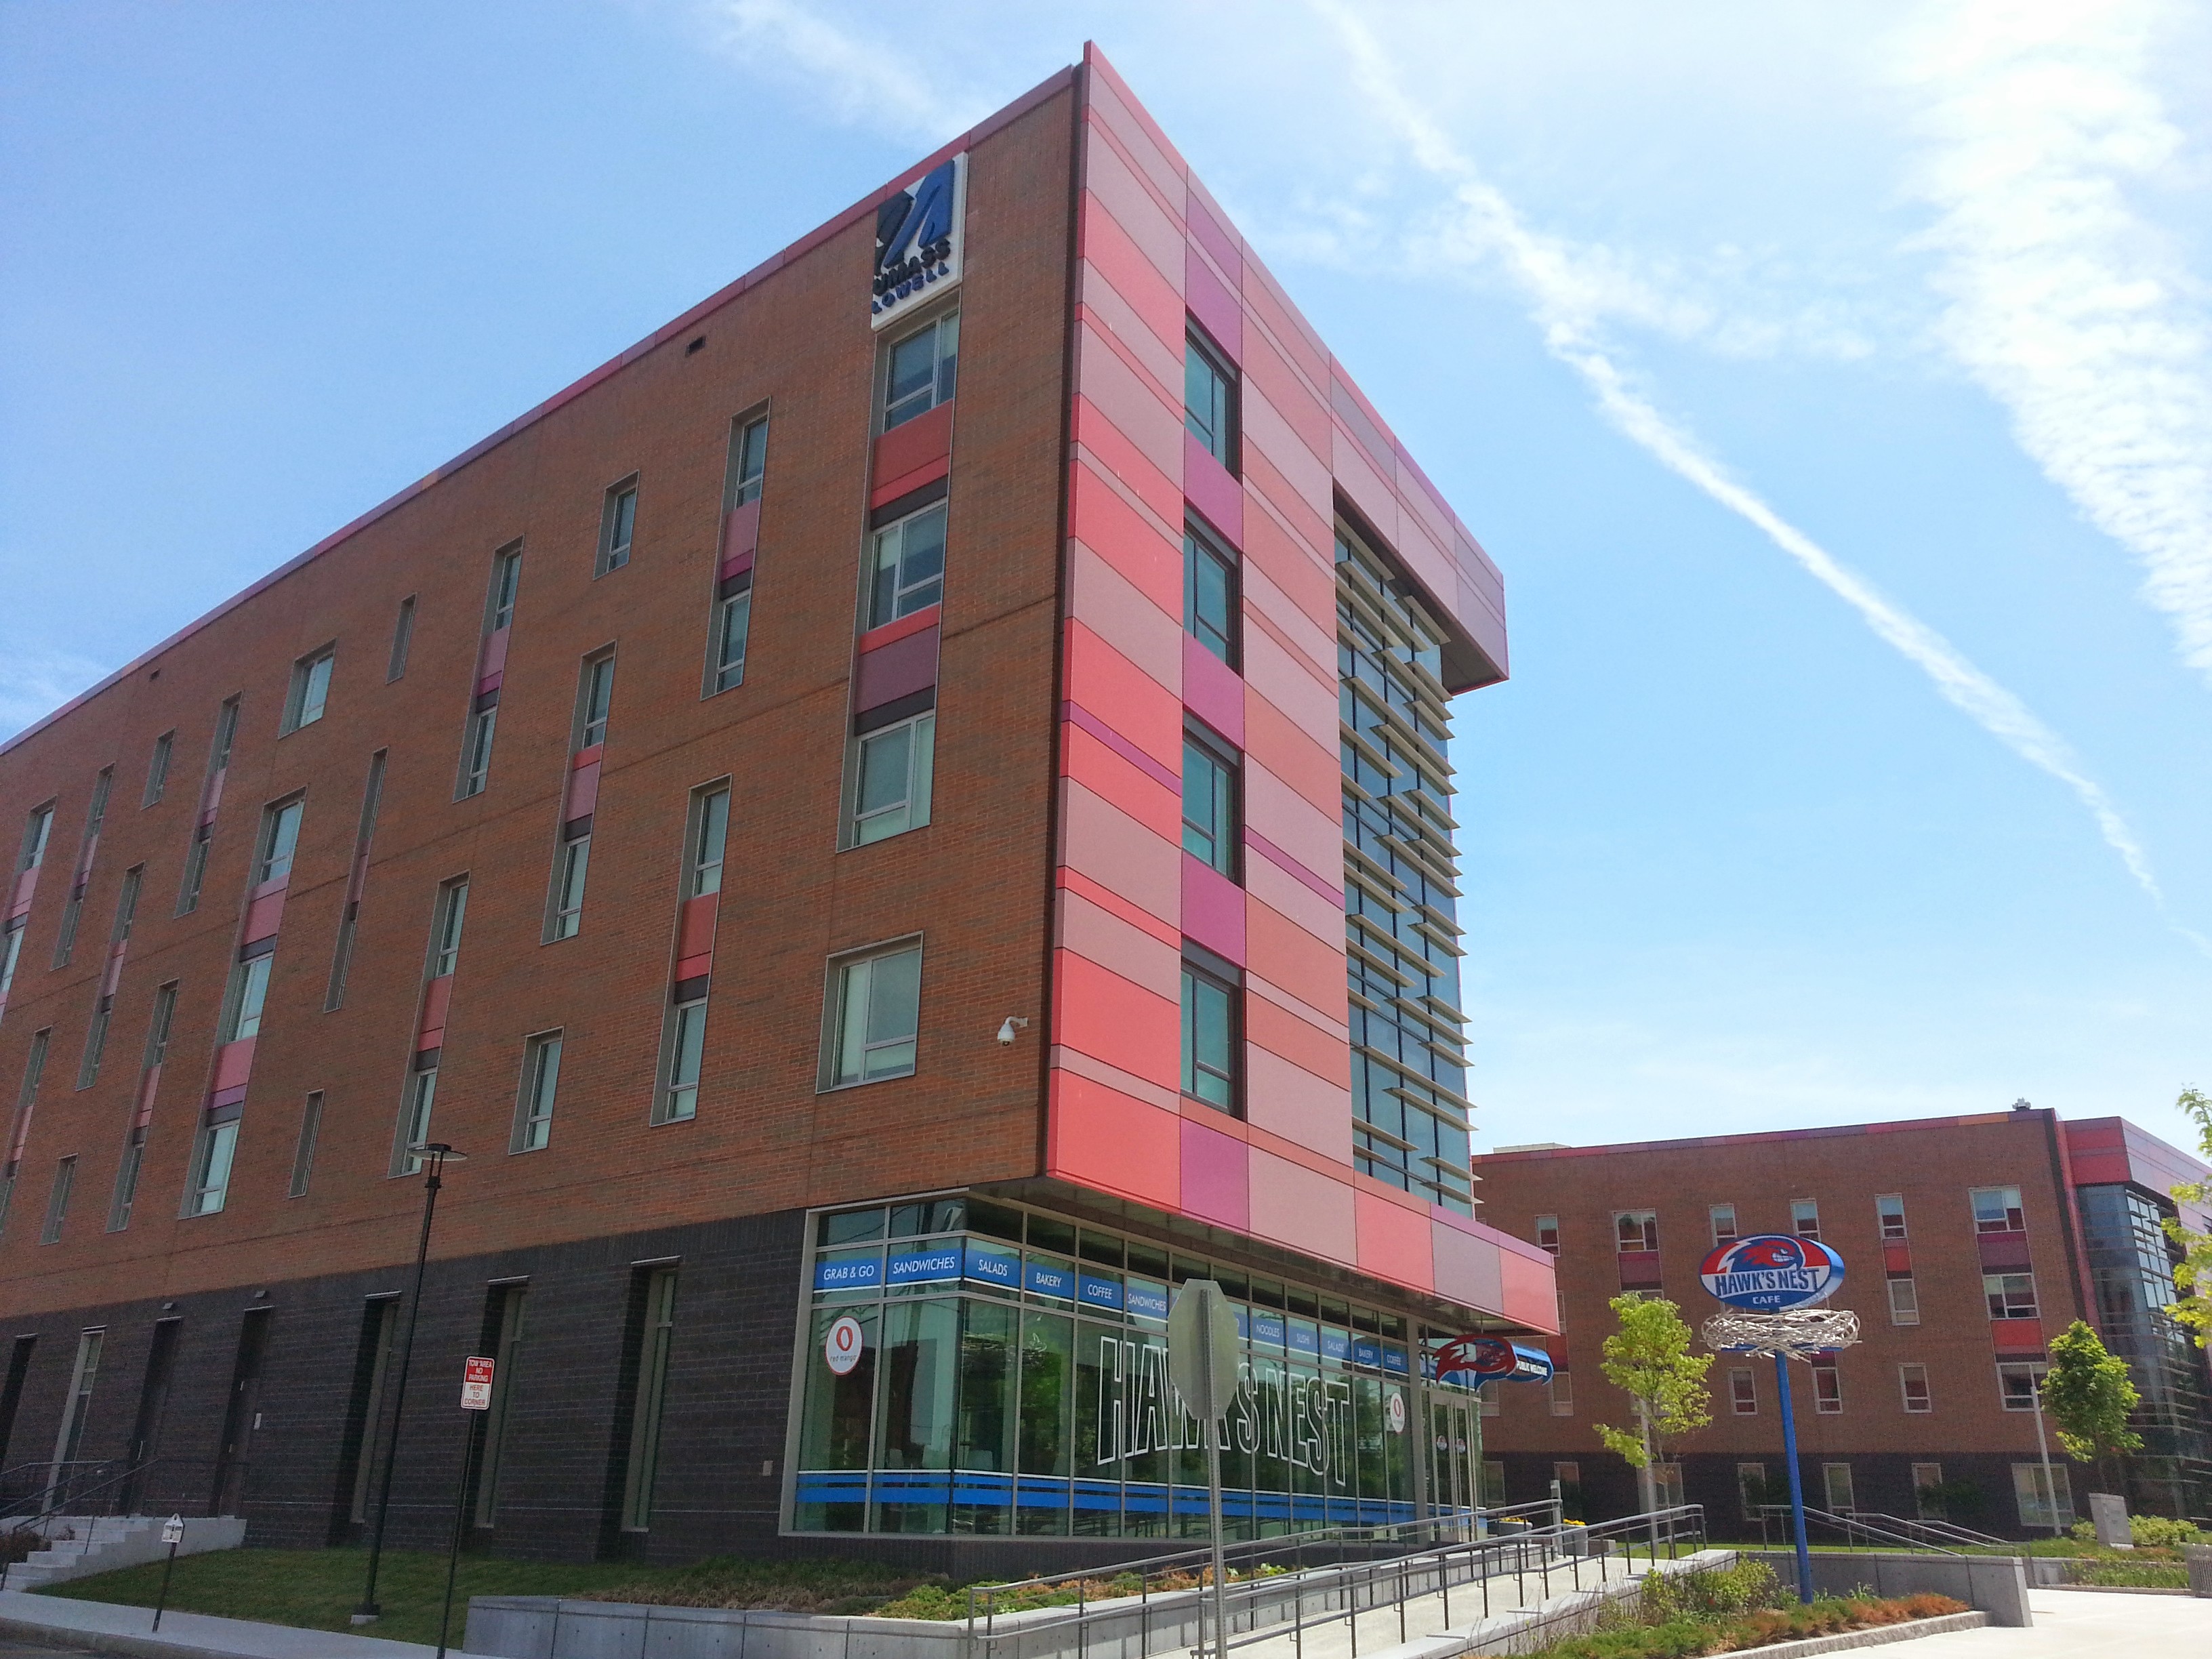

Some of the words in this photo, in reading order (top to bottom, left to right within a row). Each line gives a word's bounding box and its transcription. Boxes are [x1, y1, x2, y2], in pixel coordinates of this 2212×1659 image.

[872, 262, 949, 314] LOWELL
[823, 1268, 848, 1280] GRAB
[850, 1267, 856, 1277] &
[858, 1265, 874, 1277] GO
[893, 1256, 955, 1274] SANDWICHES
[978, 1259, 1008, 1277] SALADS
[1036, 1272, 1061, 1288] BAKERY
[1715, 1271, 1775, 1296] HAWK'S
[1777, 1267, 1819, 1290] NEST
[1088, 1284, 1112, 1299] COFFEE
[1128, 1294, 1166, 1311] SANDWICHES
[1753, 1295, 1780, 1304] CAFE
[1256, 1324, 1280, 1338] NOODLES
[1296, 1333, 1310, 1345] SUSHI
[1328, 1340, 1345, 1353] SALADS
[1359, 1347, 1373, 1359] BAKERY
[1530, 1364, 1548, 1376] WELCOME
[468, 1374, 489, 1382] PARKING
[1265, 1367, 1350, 1487] NEST
